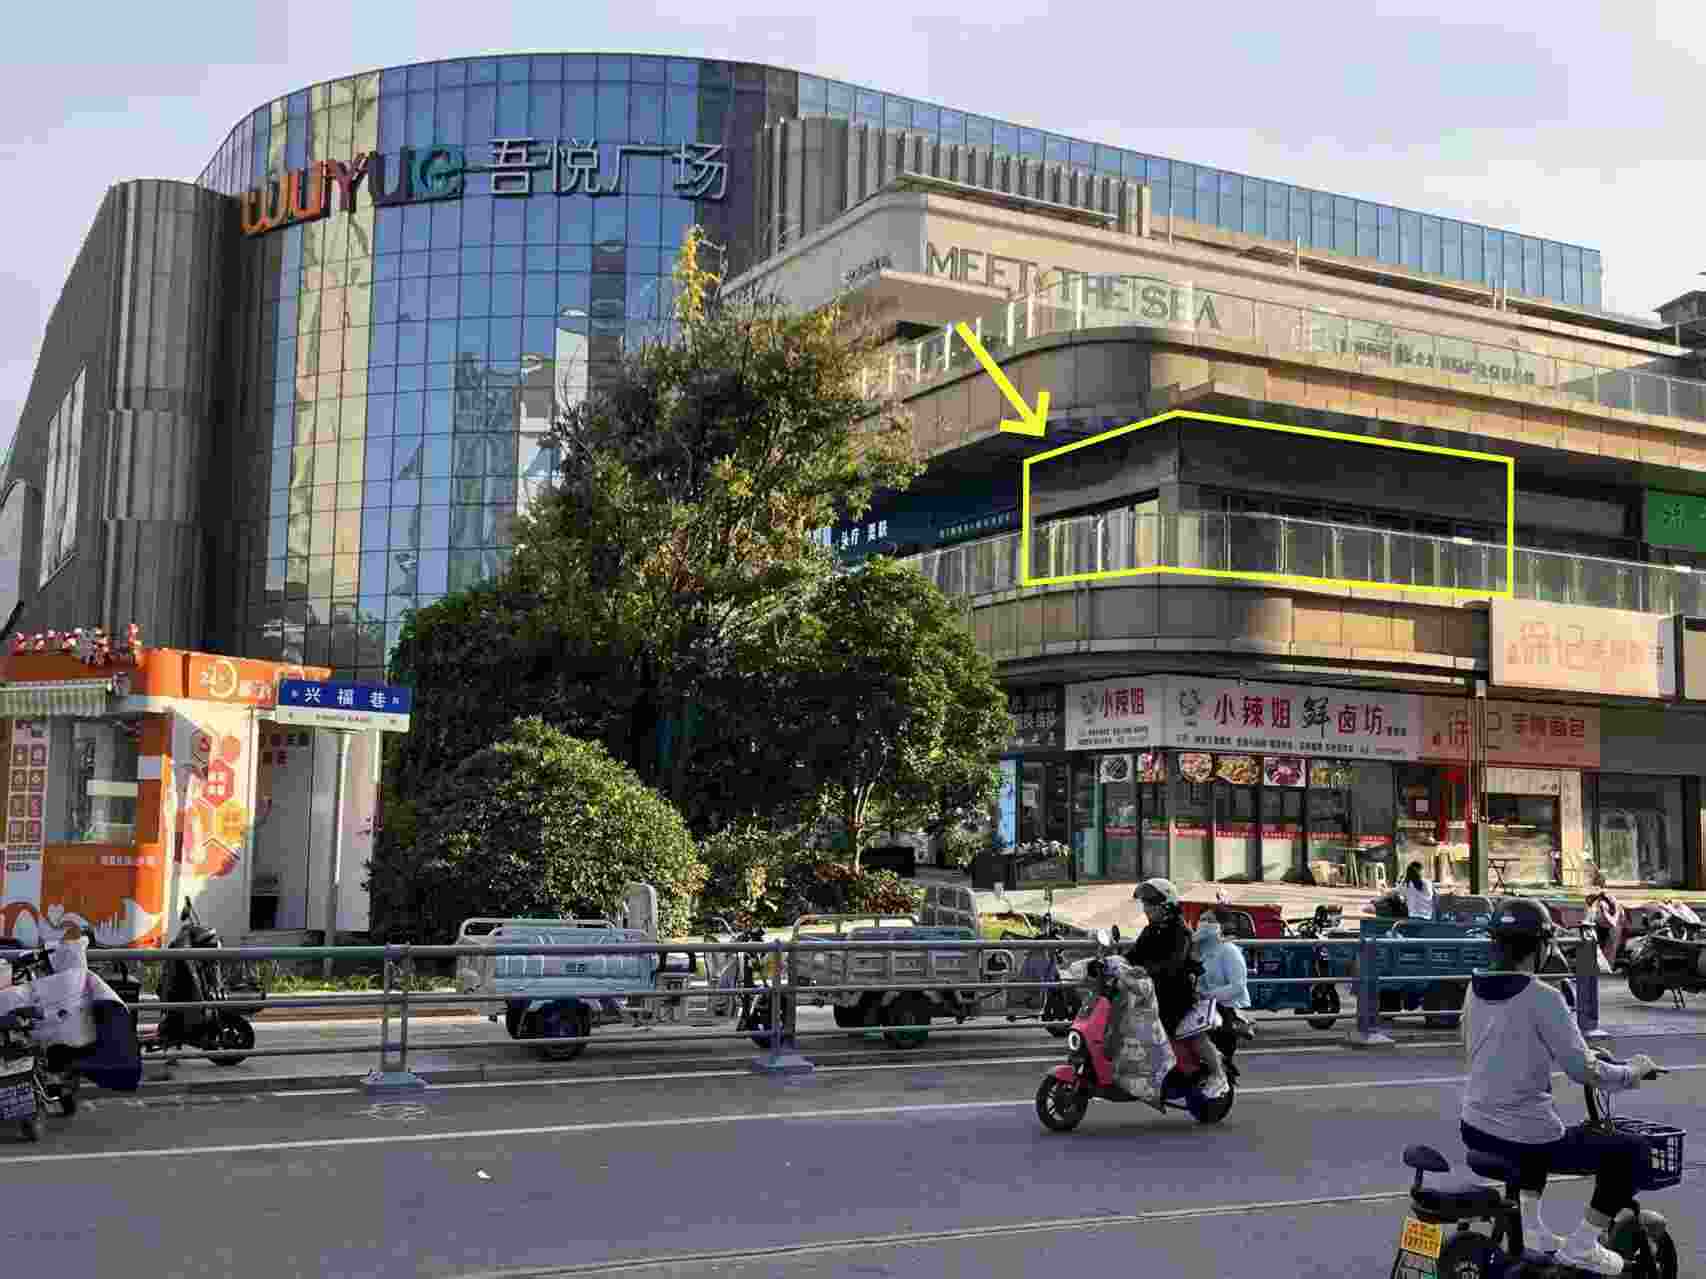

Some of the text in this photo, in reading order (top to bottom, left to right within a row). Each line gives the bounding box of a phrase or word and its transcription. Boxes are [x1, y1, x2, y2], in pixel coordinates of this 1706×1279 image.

[488, 136, 728, 199] 吾悦广场
[304, 687, 387, 708] 兴福巷
[1100, 687, 1145, 719] 小辣姐
[1213, 693, 1384, 738] 小辣姐鲜卤坊
